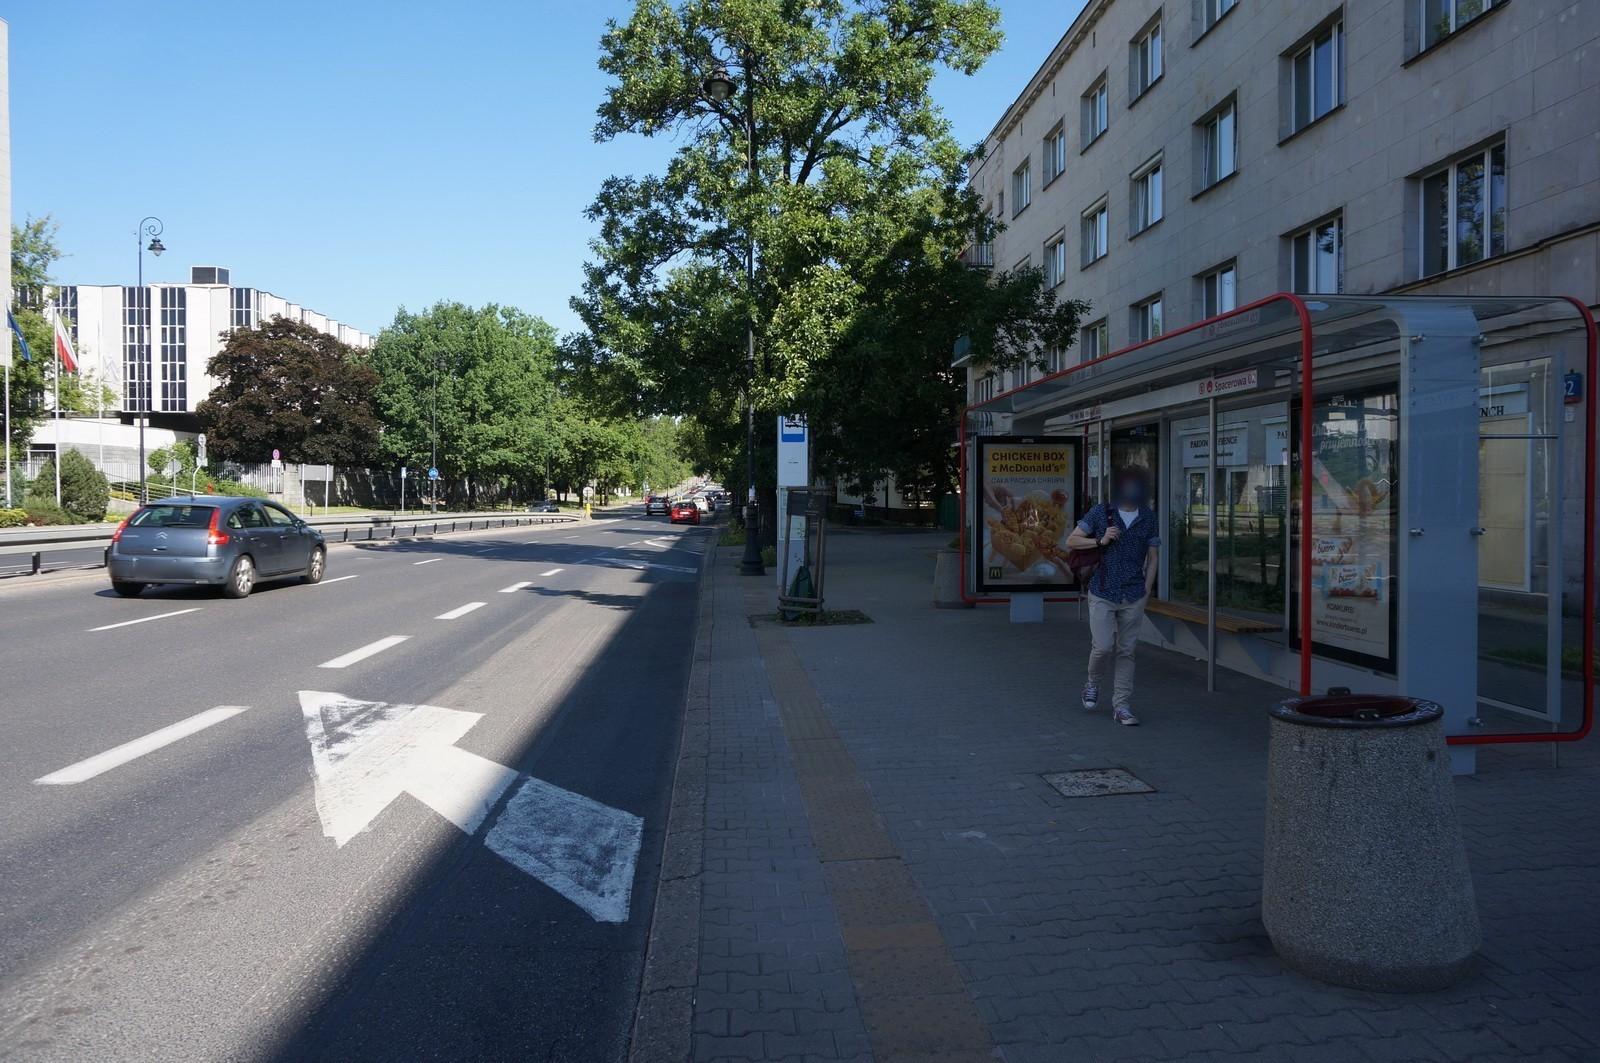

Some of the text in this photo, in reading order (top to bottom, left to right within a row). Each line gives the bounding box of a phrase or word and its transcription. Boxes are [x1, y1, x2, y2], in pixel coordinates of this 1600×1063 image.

[1214, 377, 1247, 393] Spacerowa
[1480, 405, 1505, 417] NCH
[991, 451, 1065, 461] CHICKEN BOX
[991, 465, 998, 473] z
